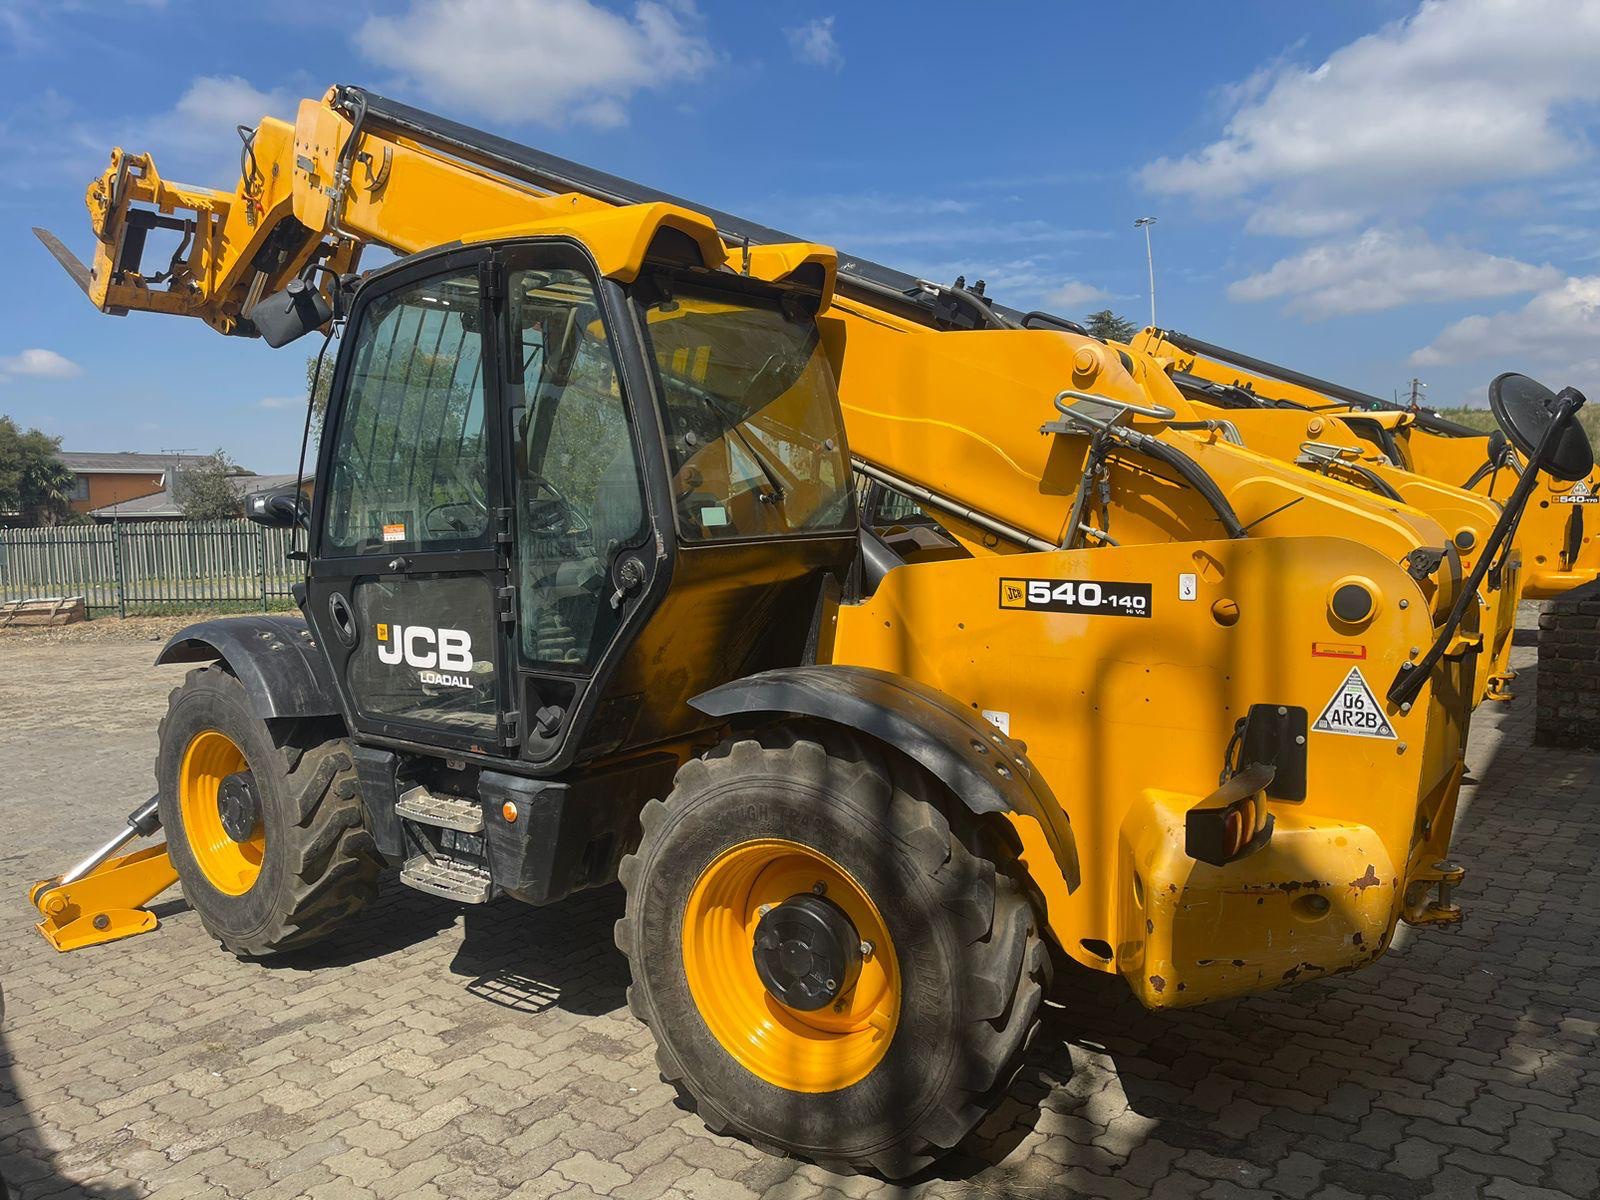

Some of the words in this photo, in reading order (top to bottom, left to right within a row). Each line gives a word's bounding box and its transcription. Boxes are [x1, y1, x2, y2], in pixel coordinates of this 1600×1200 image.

[1006, 586, 1023, 601] JCB
[1028, 581, 1146, 608] 540-140
[377, 624, 474, 673] JCB
[420, 673, 474, 689] LOADALL
[1332, 710, 1377, 728] AR2B
